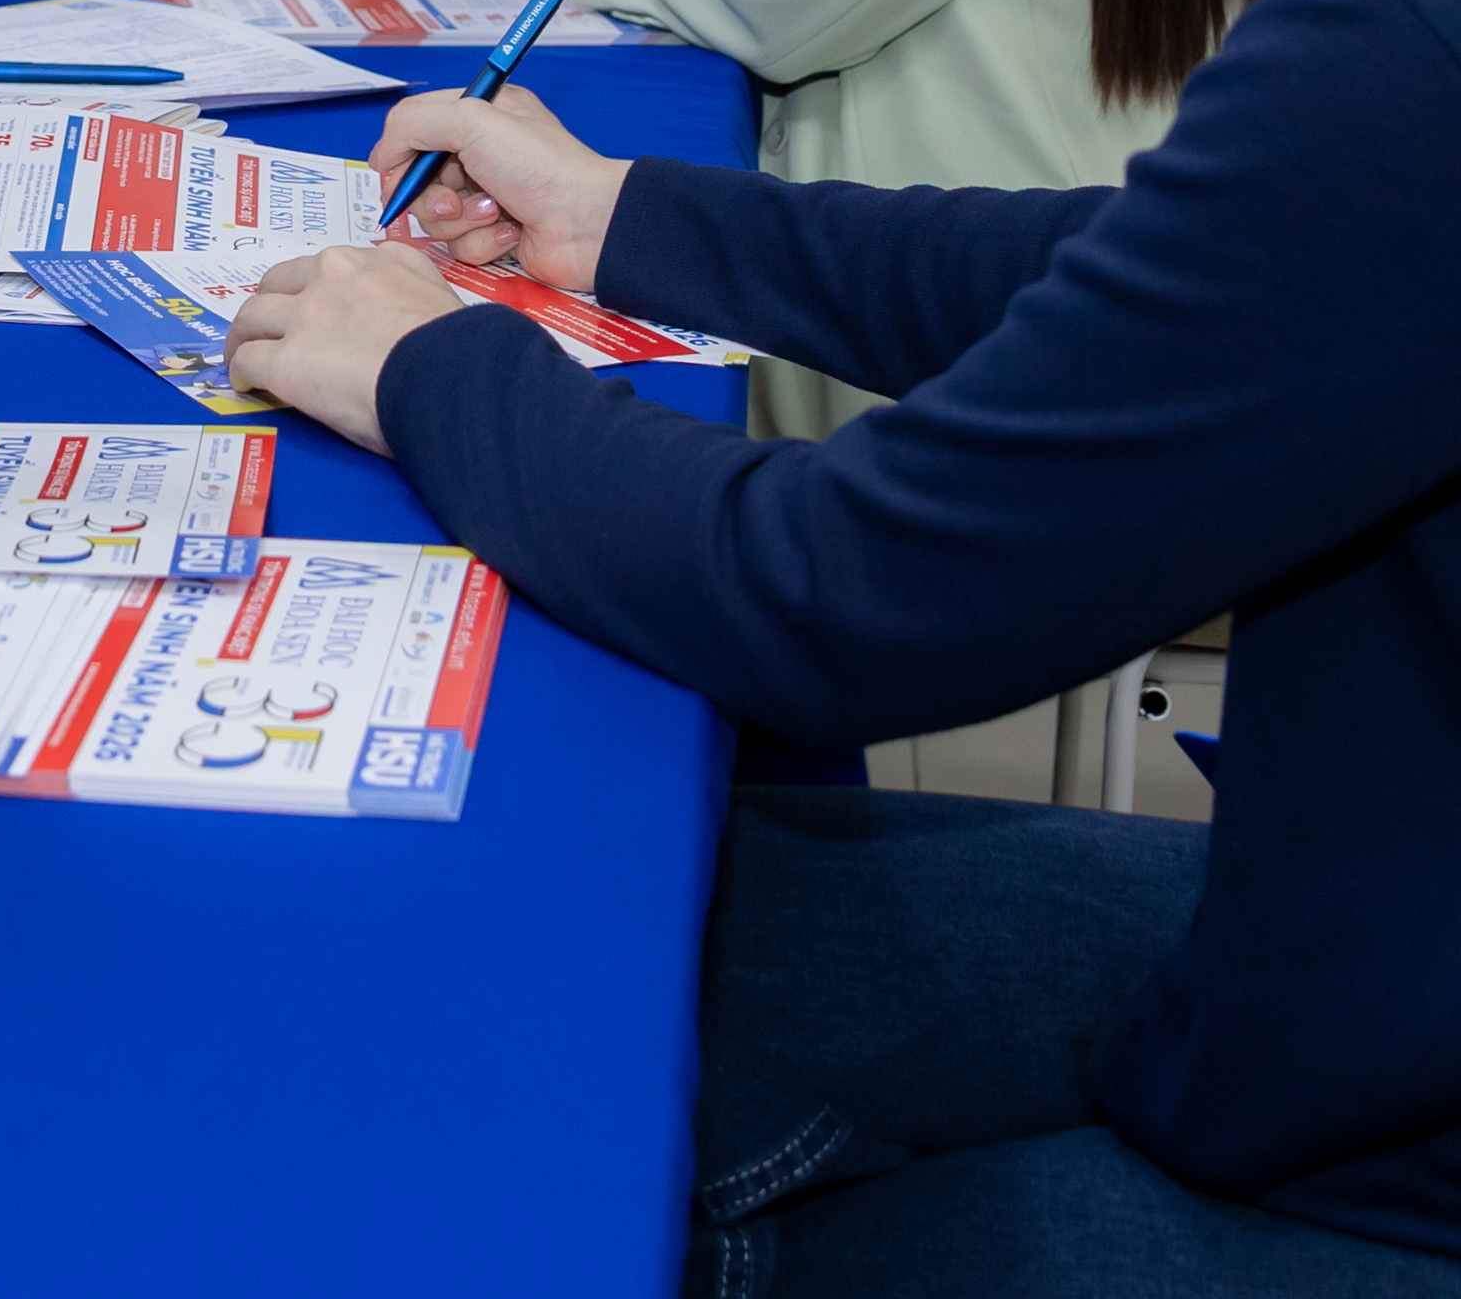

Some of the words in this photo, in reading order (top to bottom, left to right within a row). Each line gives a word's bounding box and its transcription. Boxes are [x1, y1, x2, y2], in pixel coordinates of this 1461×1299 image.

[189, 145, 225, 187] TUYỂN
[186, 186, 215, 218] SINH
[269, 184, 294, 208] HOA
[182, 220, 218, 252] NĂM
[269, 210, 294, 234] SEN
[106, 259, 136, 279] HỌC
[129, 275, 163, 300] BỔNG
[187, 319, 220, 339] NĂM
[89, 462, 125, 482] HOA
[180, 537, 227, 574] HSU
[281, 593, 327, 629] HOA
[145, 611, 198, 657] SINH
[269, 631, 312, 668] SEN
[122, 659, 178, 707] NĂM
[94, 711, 151, 762] 2026
[360, 729, 419, 789] HSU
